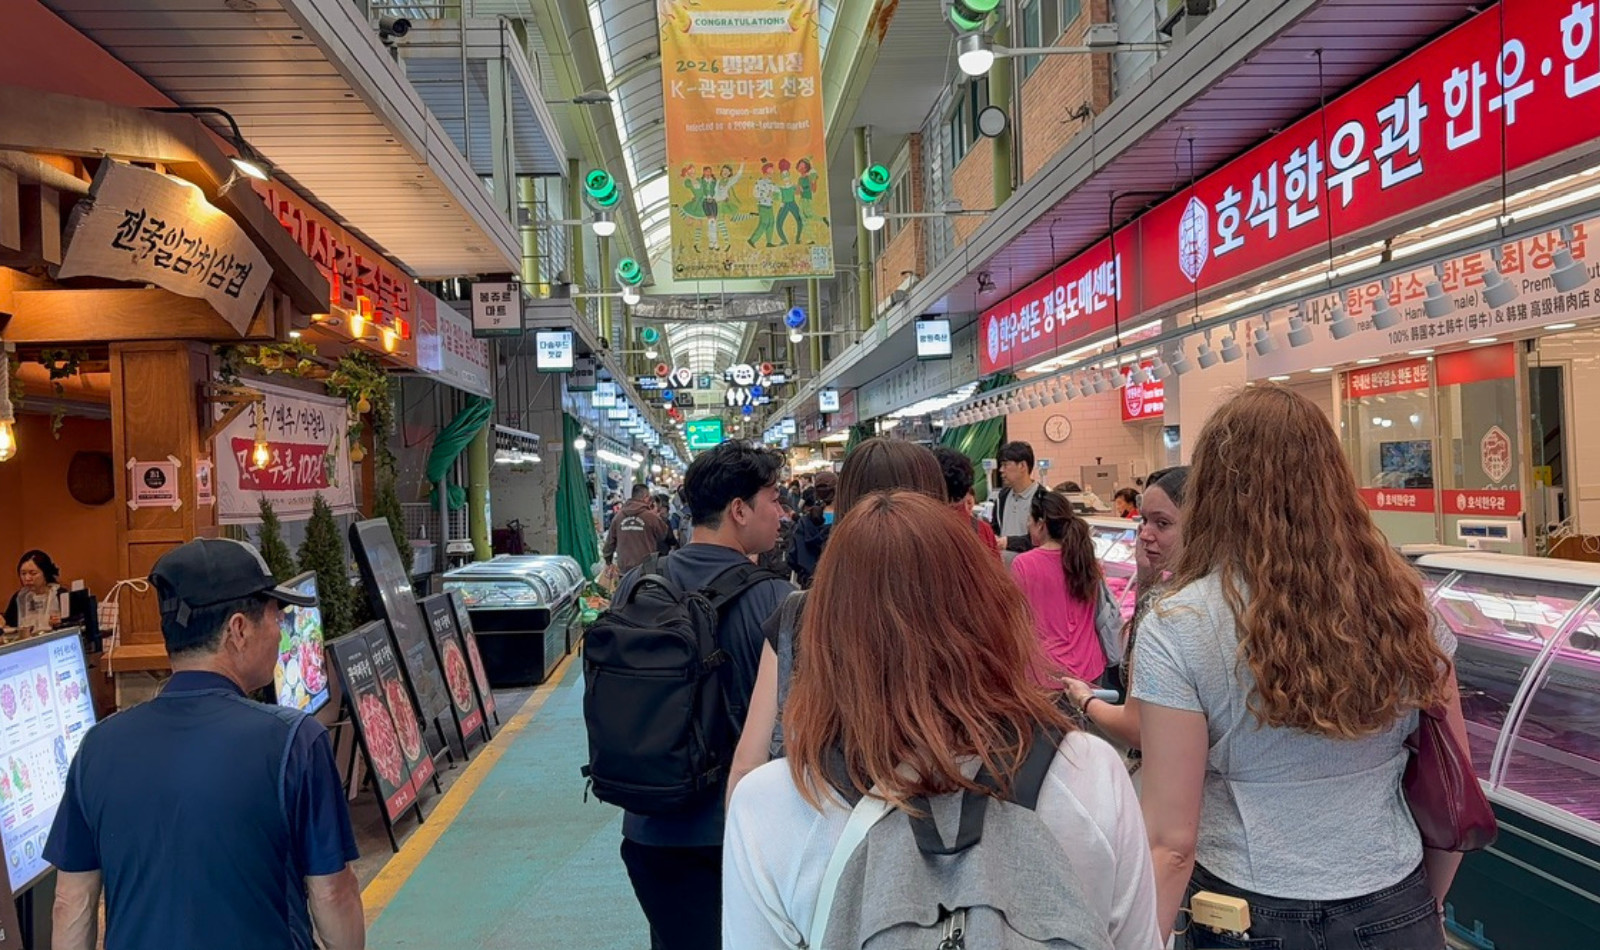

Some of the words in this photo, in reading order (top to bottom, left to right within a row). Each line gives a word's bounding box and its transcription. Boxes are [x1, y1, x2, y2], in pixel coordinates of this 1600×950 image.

[694, 17, 786, 27] CONGRATULATIONS
[676, 59, 719, 73] 2026
[722, 52, 803, 75] 망원시장
[671, 77, 775, 99] K-관광마켓
[781, 76, 815, 97] 선정
[1214, 82, 1428, 257] 호식한우관
[112, 208, 252, 298] 전국일김치삼겹
[480, 292, 512, 303] 봉쥬르
[1000, 300, 1041, 352] 한우·한돈
[1043, 252, 1121, 333] 정육도매센터
[486, 305, 506, 316] 마트
[1388, 329, 1410, 344] 100%
[1530, 290, 1590, 318] 高级精肉店
[1352, 373, 1371, 390] 국내산
[1385, 494, 1416, 507] 호식한우관
[1467, 496, 1506, 510] 호식한우관
